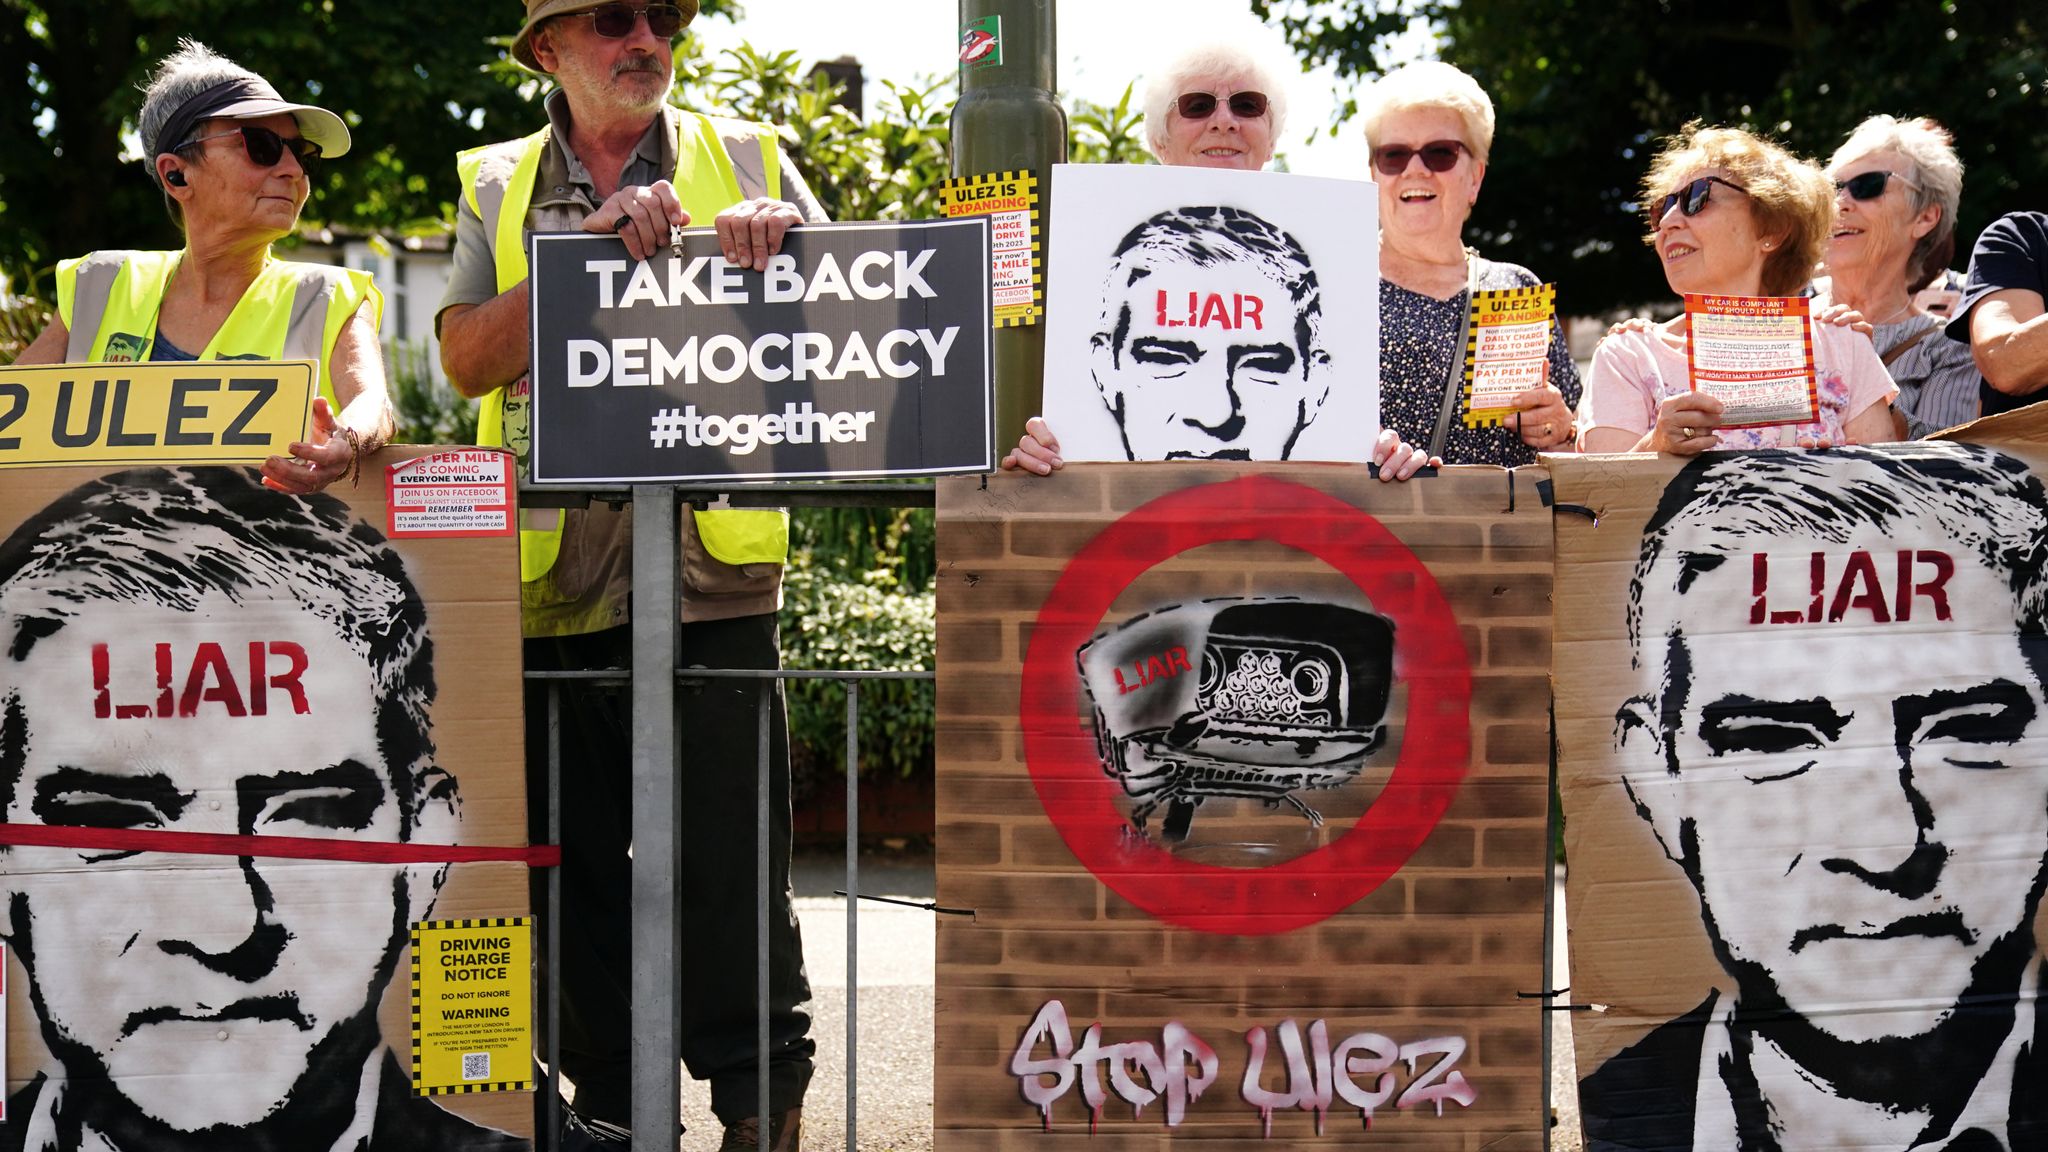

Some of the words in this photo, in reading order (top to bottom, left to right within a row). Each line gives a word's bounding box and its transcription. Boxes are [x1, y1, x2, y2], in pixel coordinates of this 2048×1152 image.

[956, 186, 996, 202] ULEZ
[1001, 183, 1016, 196] IS
[949, 197, 1026, 215] EXPANDING
[995, 231, 1025, 239] DRIVE
[1002, 259, 1029, 269] MILE
[585, 256, 749, 309] TAKE
[764, 249, 938, 303] BACK
[993, 289, 1029, 298] ACEBOOK
[1157, 290, 1264, 330] LIAR
[1491, 300, 1528, 312] ULEZ
[1533, 297, 1541, 309] IS
[1481, 309, 1546, 324] EXPANDING
[1485, 335, 1511, 343] DAILY
[1513, 332, 1544, 341] CHARGE
[1500, 327, 1533, 335] compliant
[1524, 340, 1545, 348] DRIVE
[567, 326, 960, 388] DEMOCRACY
[1476, 370, 1498, 378] PAY
[1502, 368, 1522, 376] PER
[1498, 377, 1534, 385] COMING
[510, 381, 530, 397] LIA
[0, 383, 30, 450] 2
[51, 378, 278, 447] ULEZ
[650, 402, 875, 455] #together
[432, 453, 460, 463] PER
[465, 453, 499, 463] MILE
[416, 465, 426, 475] IS
[430, 465, 480, 474] COMING
[400, 475, 450, 483] EVERYONE
[401, 489, 420, 498] JOIN
[428, 505, 473, 513] REMEMBER
[1750, 550, 1954, 624] LIAR
[1114, 646, 1192, 695] LIAR
[92, 641, 312, 719] LIAR
[441, 937, 510, 952] DRIVING
[441, 952, 510, 967] CHARGE
[445, 967, 507, 982] NOTICE
[478, 990, 510, 998] IGNORE
[442, 1007, 510, 1020] WARNING
[1010, 1000, 1219, 1132] Stop
[1241, 1018, 1477, 1132] Ulez
